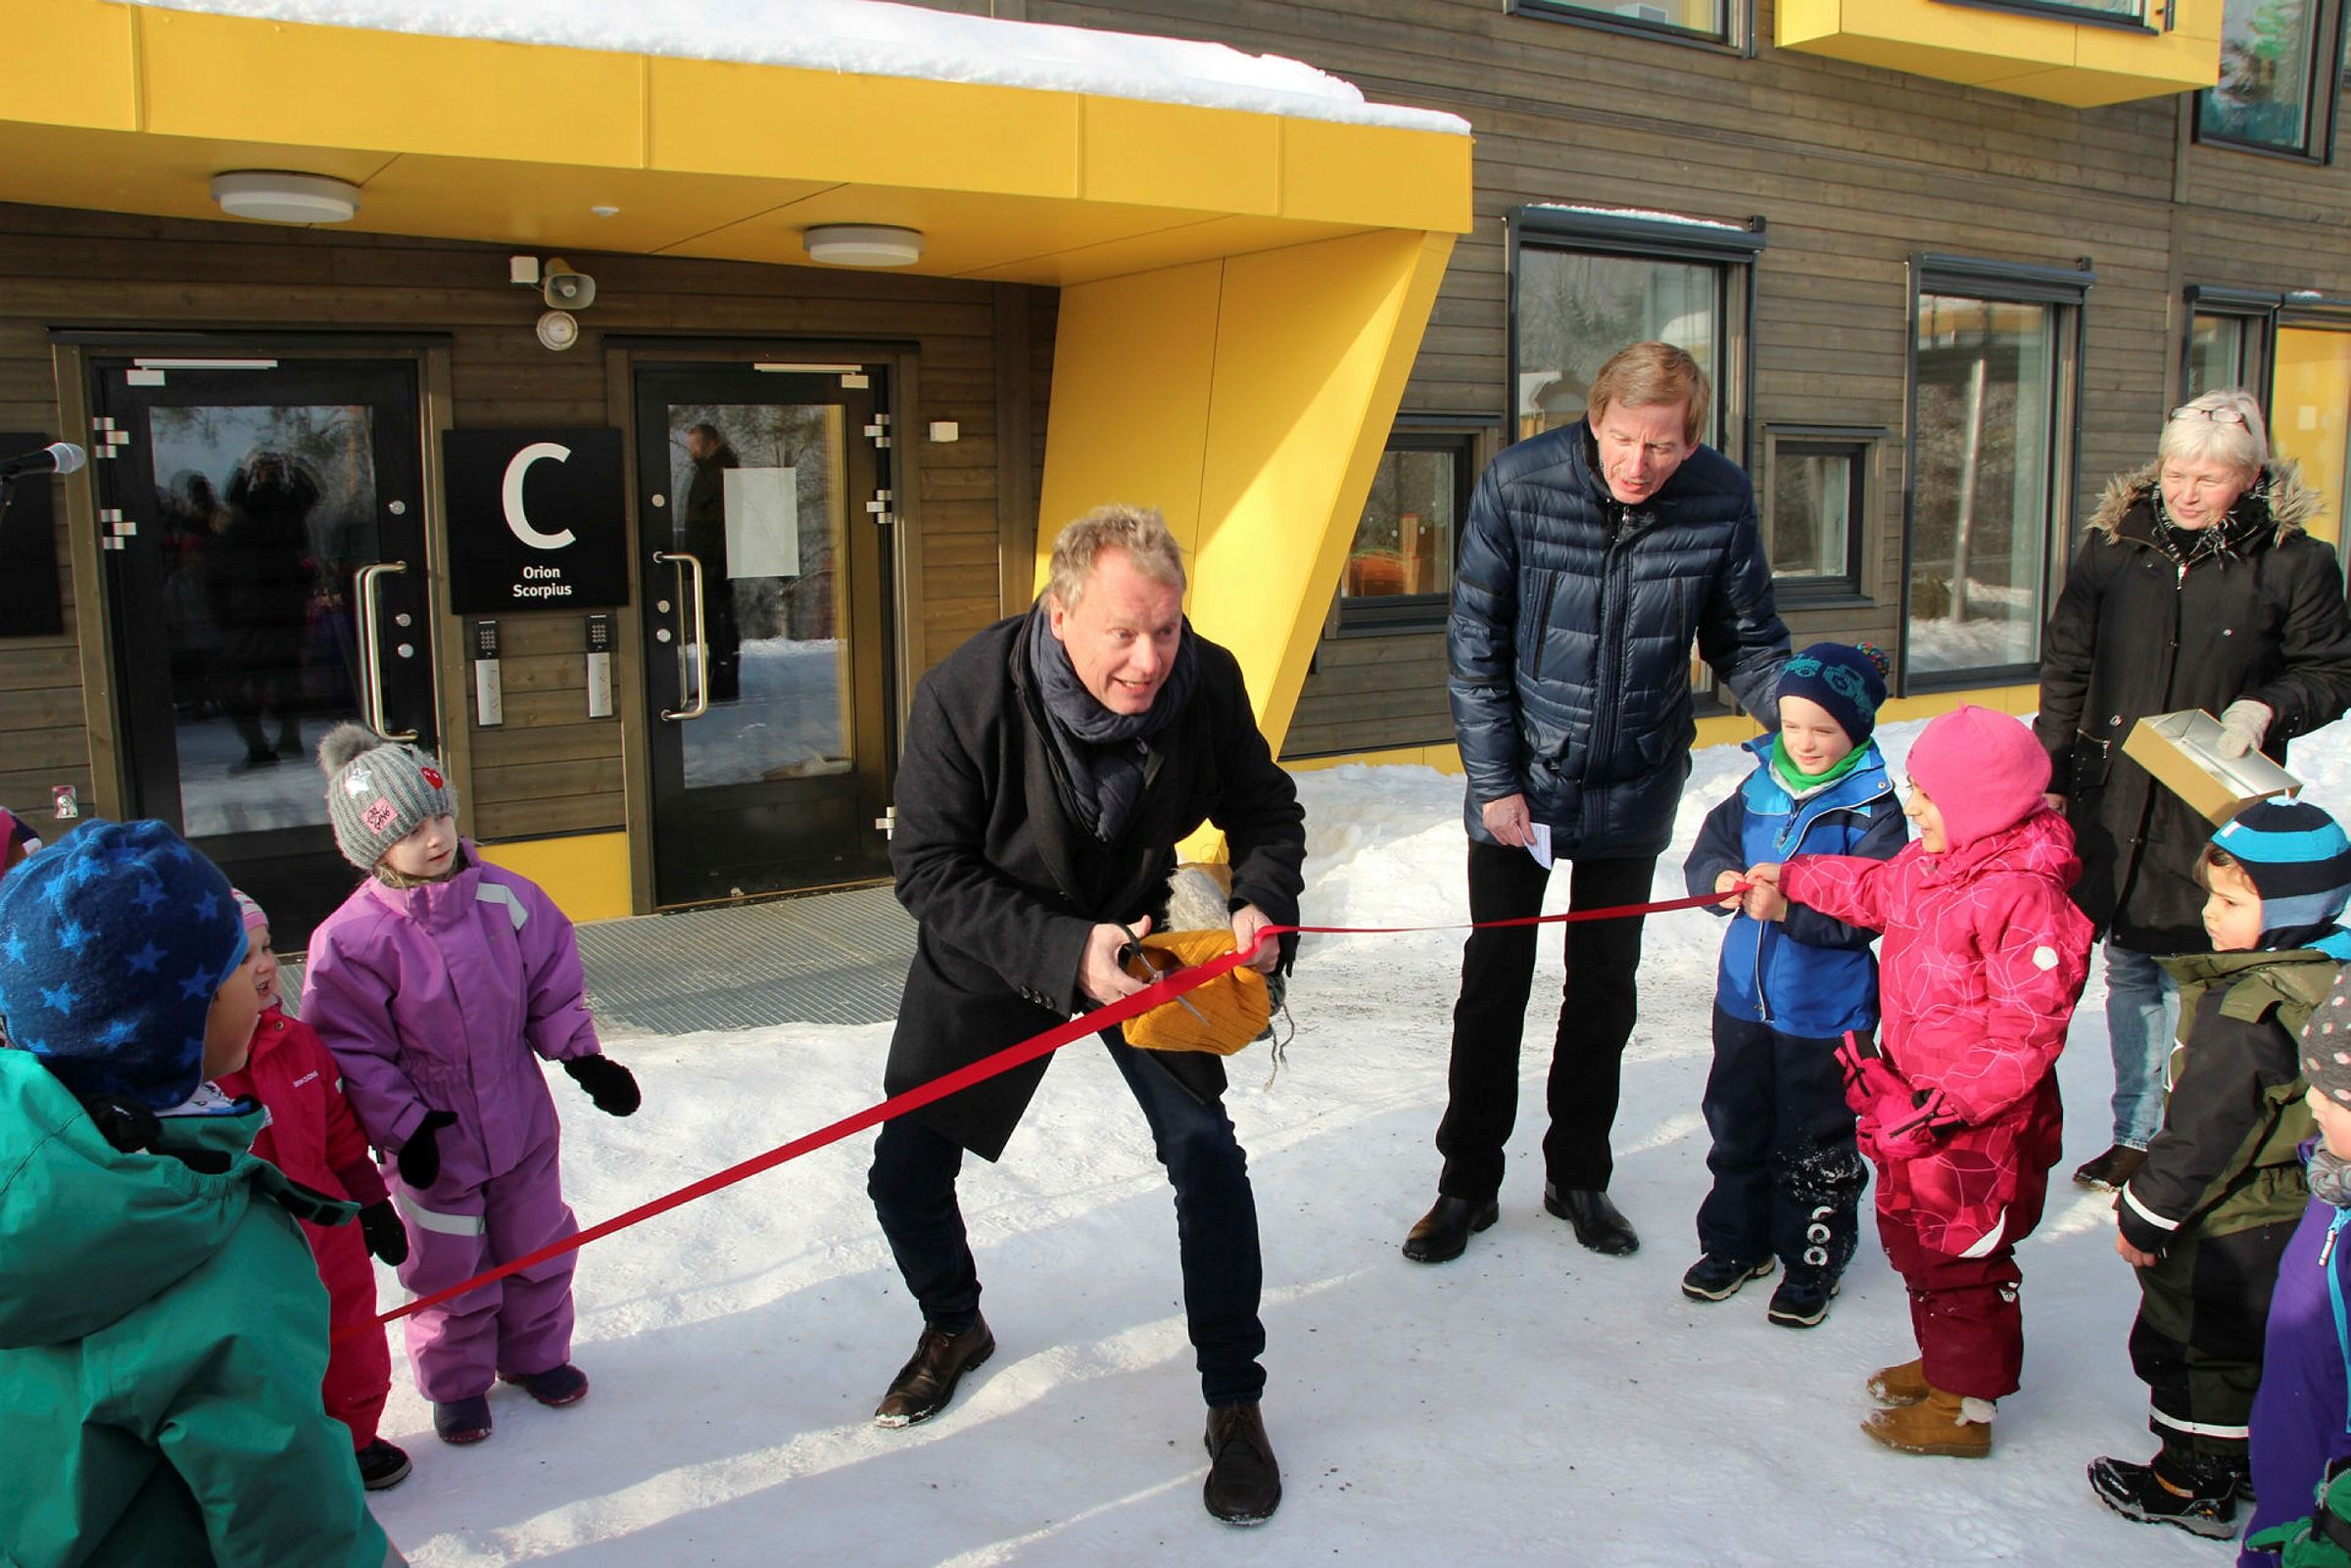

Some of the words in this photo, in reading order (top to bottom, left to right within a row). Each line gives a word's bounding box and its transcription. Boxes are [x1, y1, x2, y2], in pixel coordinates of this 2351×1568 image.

[502, 442, 576, 549] C
[522, 565, 561, 580] Orion
[512, 582, 572, 599] Scorpius
